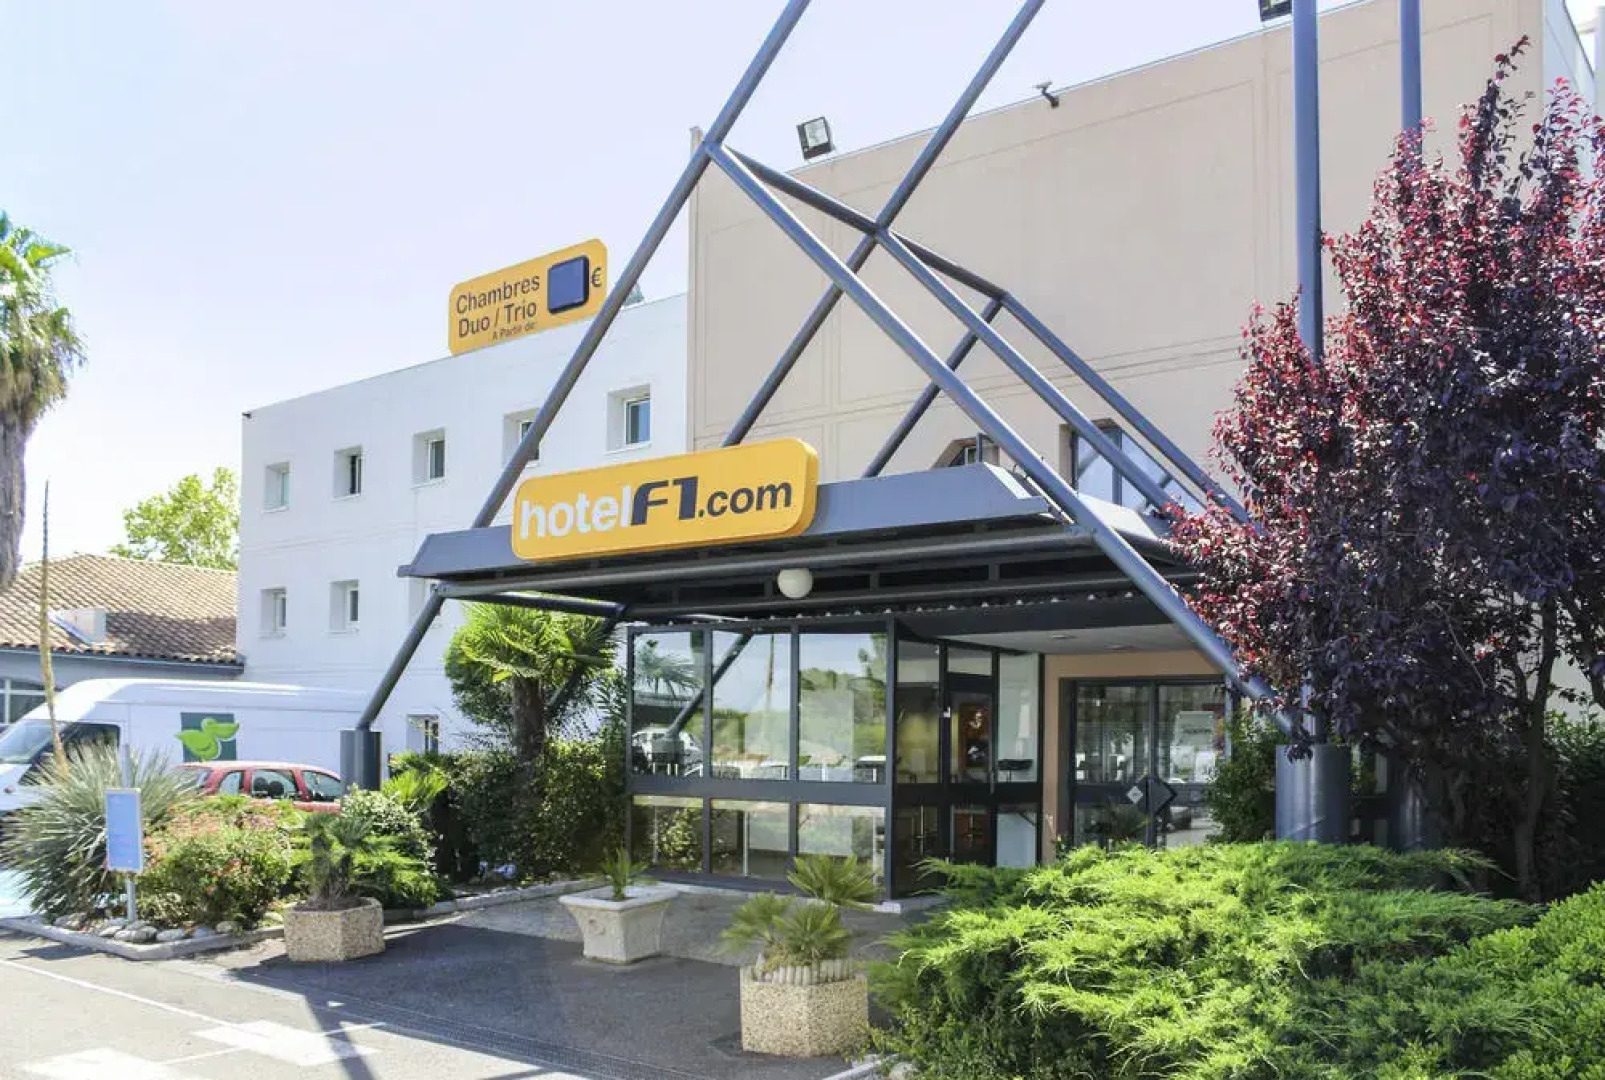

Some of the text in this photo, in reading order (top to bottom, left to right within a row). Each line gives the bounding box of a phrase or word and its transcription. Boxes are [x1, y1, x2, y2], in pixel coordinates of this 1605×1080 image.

[456, 275, 540, 314] Chambres
[591, 267, 602, 288] €
[458, 316, 490, 338] Duo
[504, 301, 537, 323] Trio
[519, 476, 792, 540] hotelF1.com
